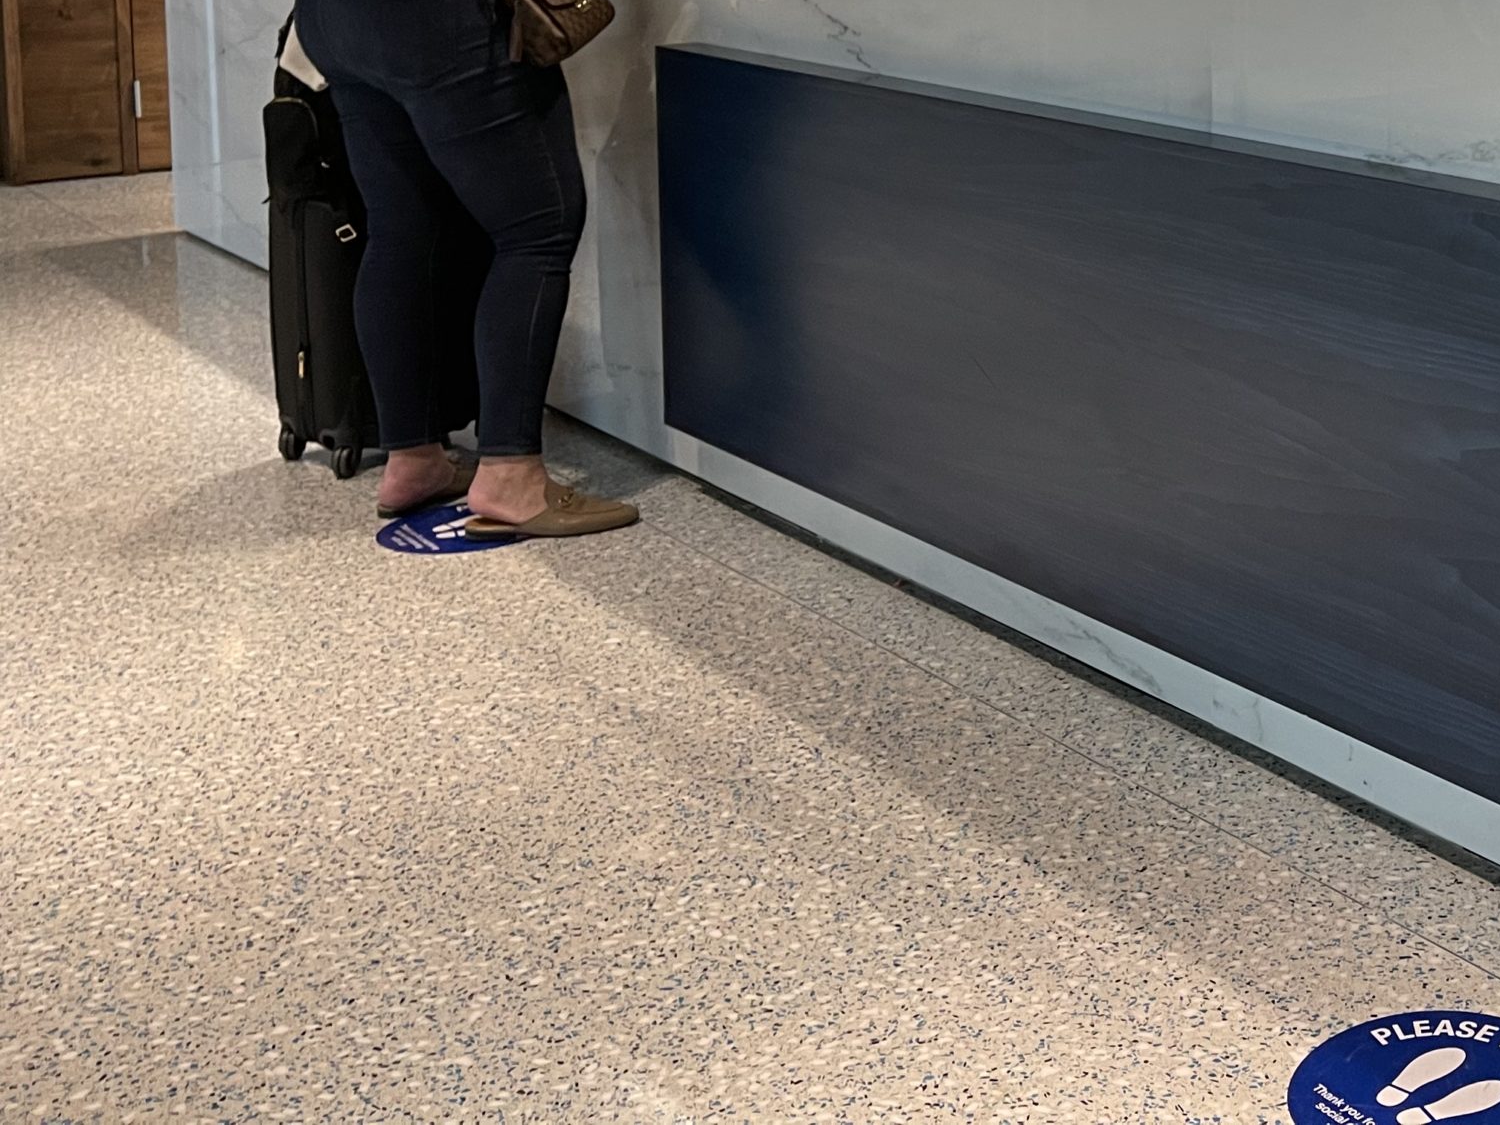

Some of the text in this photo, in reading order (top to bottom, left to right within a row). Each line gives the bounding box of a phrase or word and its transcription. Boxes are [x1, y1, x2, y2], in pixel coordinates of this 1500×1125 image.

[1370, 1019, 1500, 1046] PLEASE
[1313, 1083, 1346, 1108] Thank
[1339, 1104, 1365, 1121] you
[1315, 1102, 1350, 1124] social
